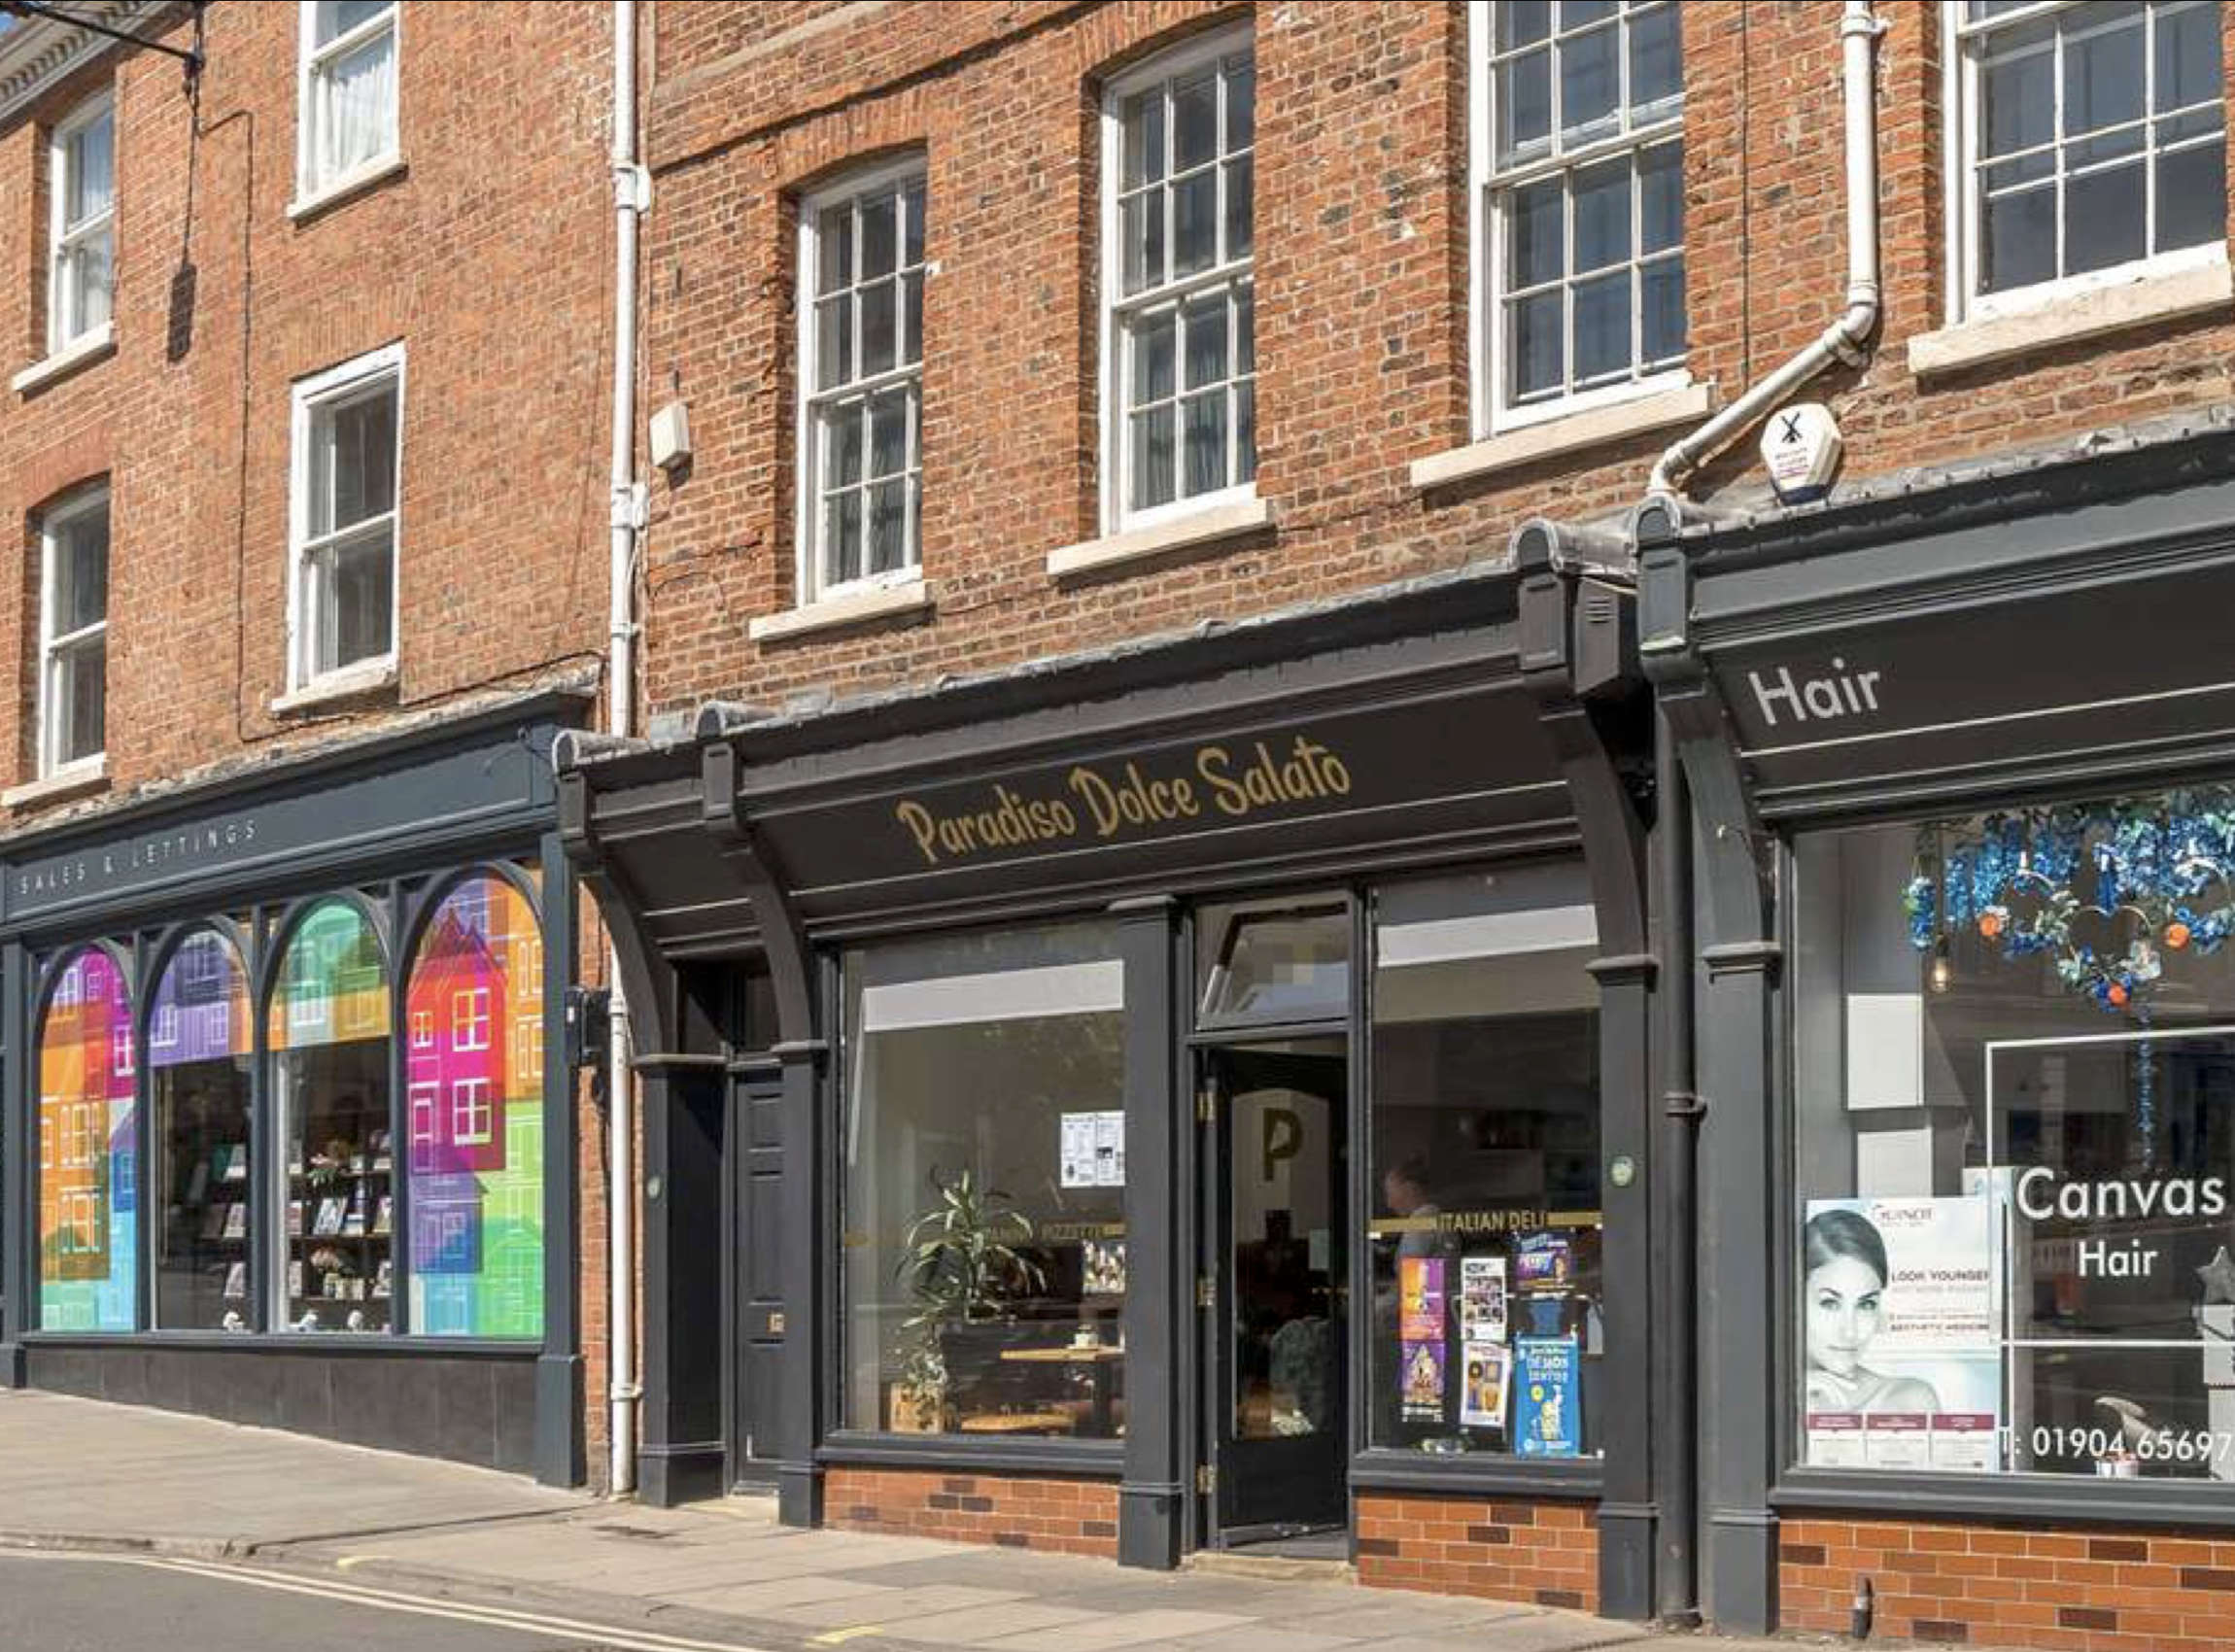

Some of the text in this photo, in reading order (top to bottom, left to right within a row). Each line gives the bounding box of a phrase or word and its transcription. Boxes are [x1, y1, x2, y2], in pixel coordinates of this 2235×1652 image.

[1748, 657, 1880, 725] Hair
[896, 736, 1352, 865] Paradiso Dolce Salato
[18, 862, 86, 895] SALES
[131, 819, 257, 867] LETTINGS
[1263, 1108, 1303, 1182] P
[2017, 1166, 2225, 1220] Canvas
[1440, 1209, 1545, 1233] ITALIAN DELI
[1891, 1269, 1926, 1282] LOOK
[2078, 1239, 2159, 1277] Hair
[2031, 1426, 2126, 1458] 01904
